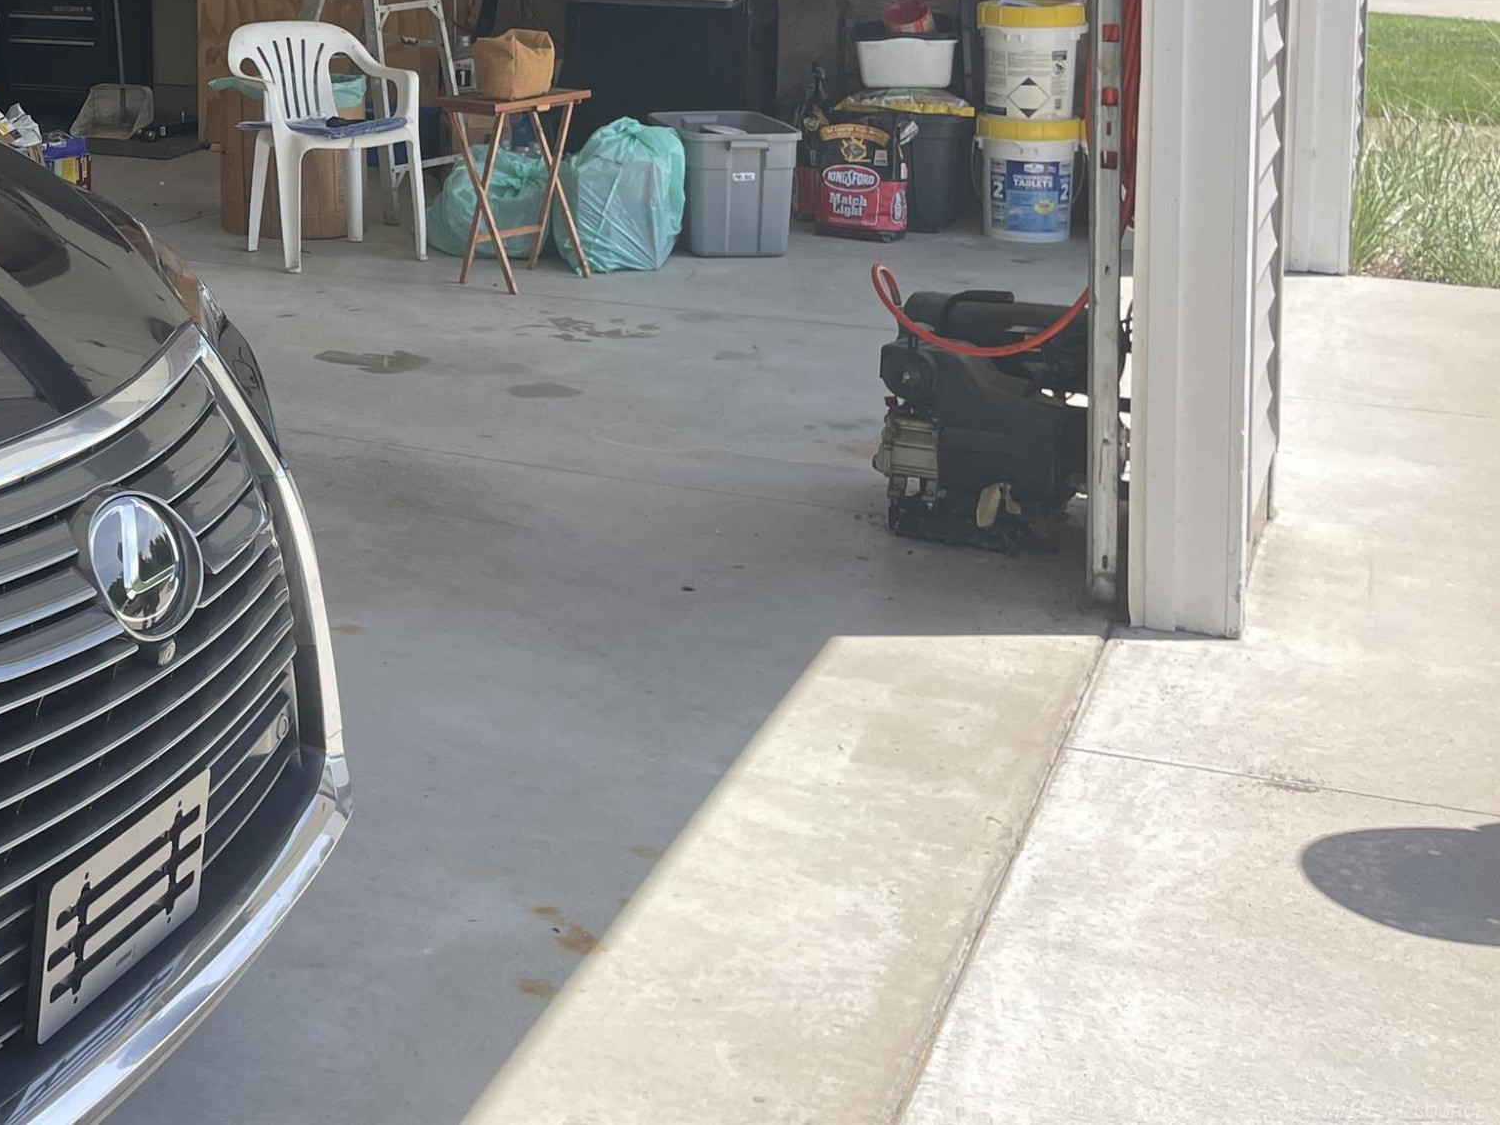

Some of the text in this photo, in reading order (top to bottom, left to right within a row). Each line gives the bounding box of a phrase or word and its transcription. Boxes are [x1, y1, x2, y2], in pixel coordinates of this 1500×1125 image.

[459, 70, 466, 86] 1
[827, 170, 875, 187] KINGSFORD
[1014, 179, 1053, 187] TABLETS
[993, 181, 1004, 198] 2
[1060, 183, 1069, 201] 2
[829, 192, 868, 207] Match
[833, 202, 863, 217] Light
